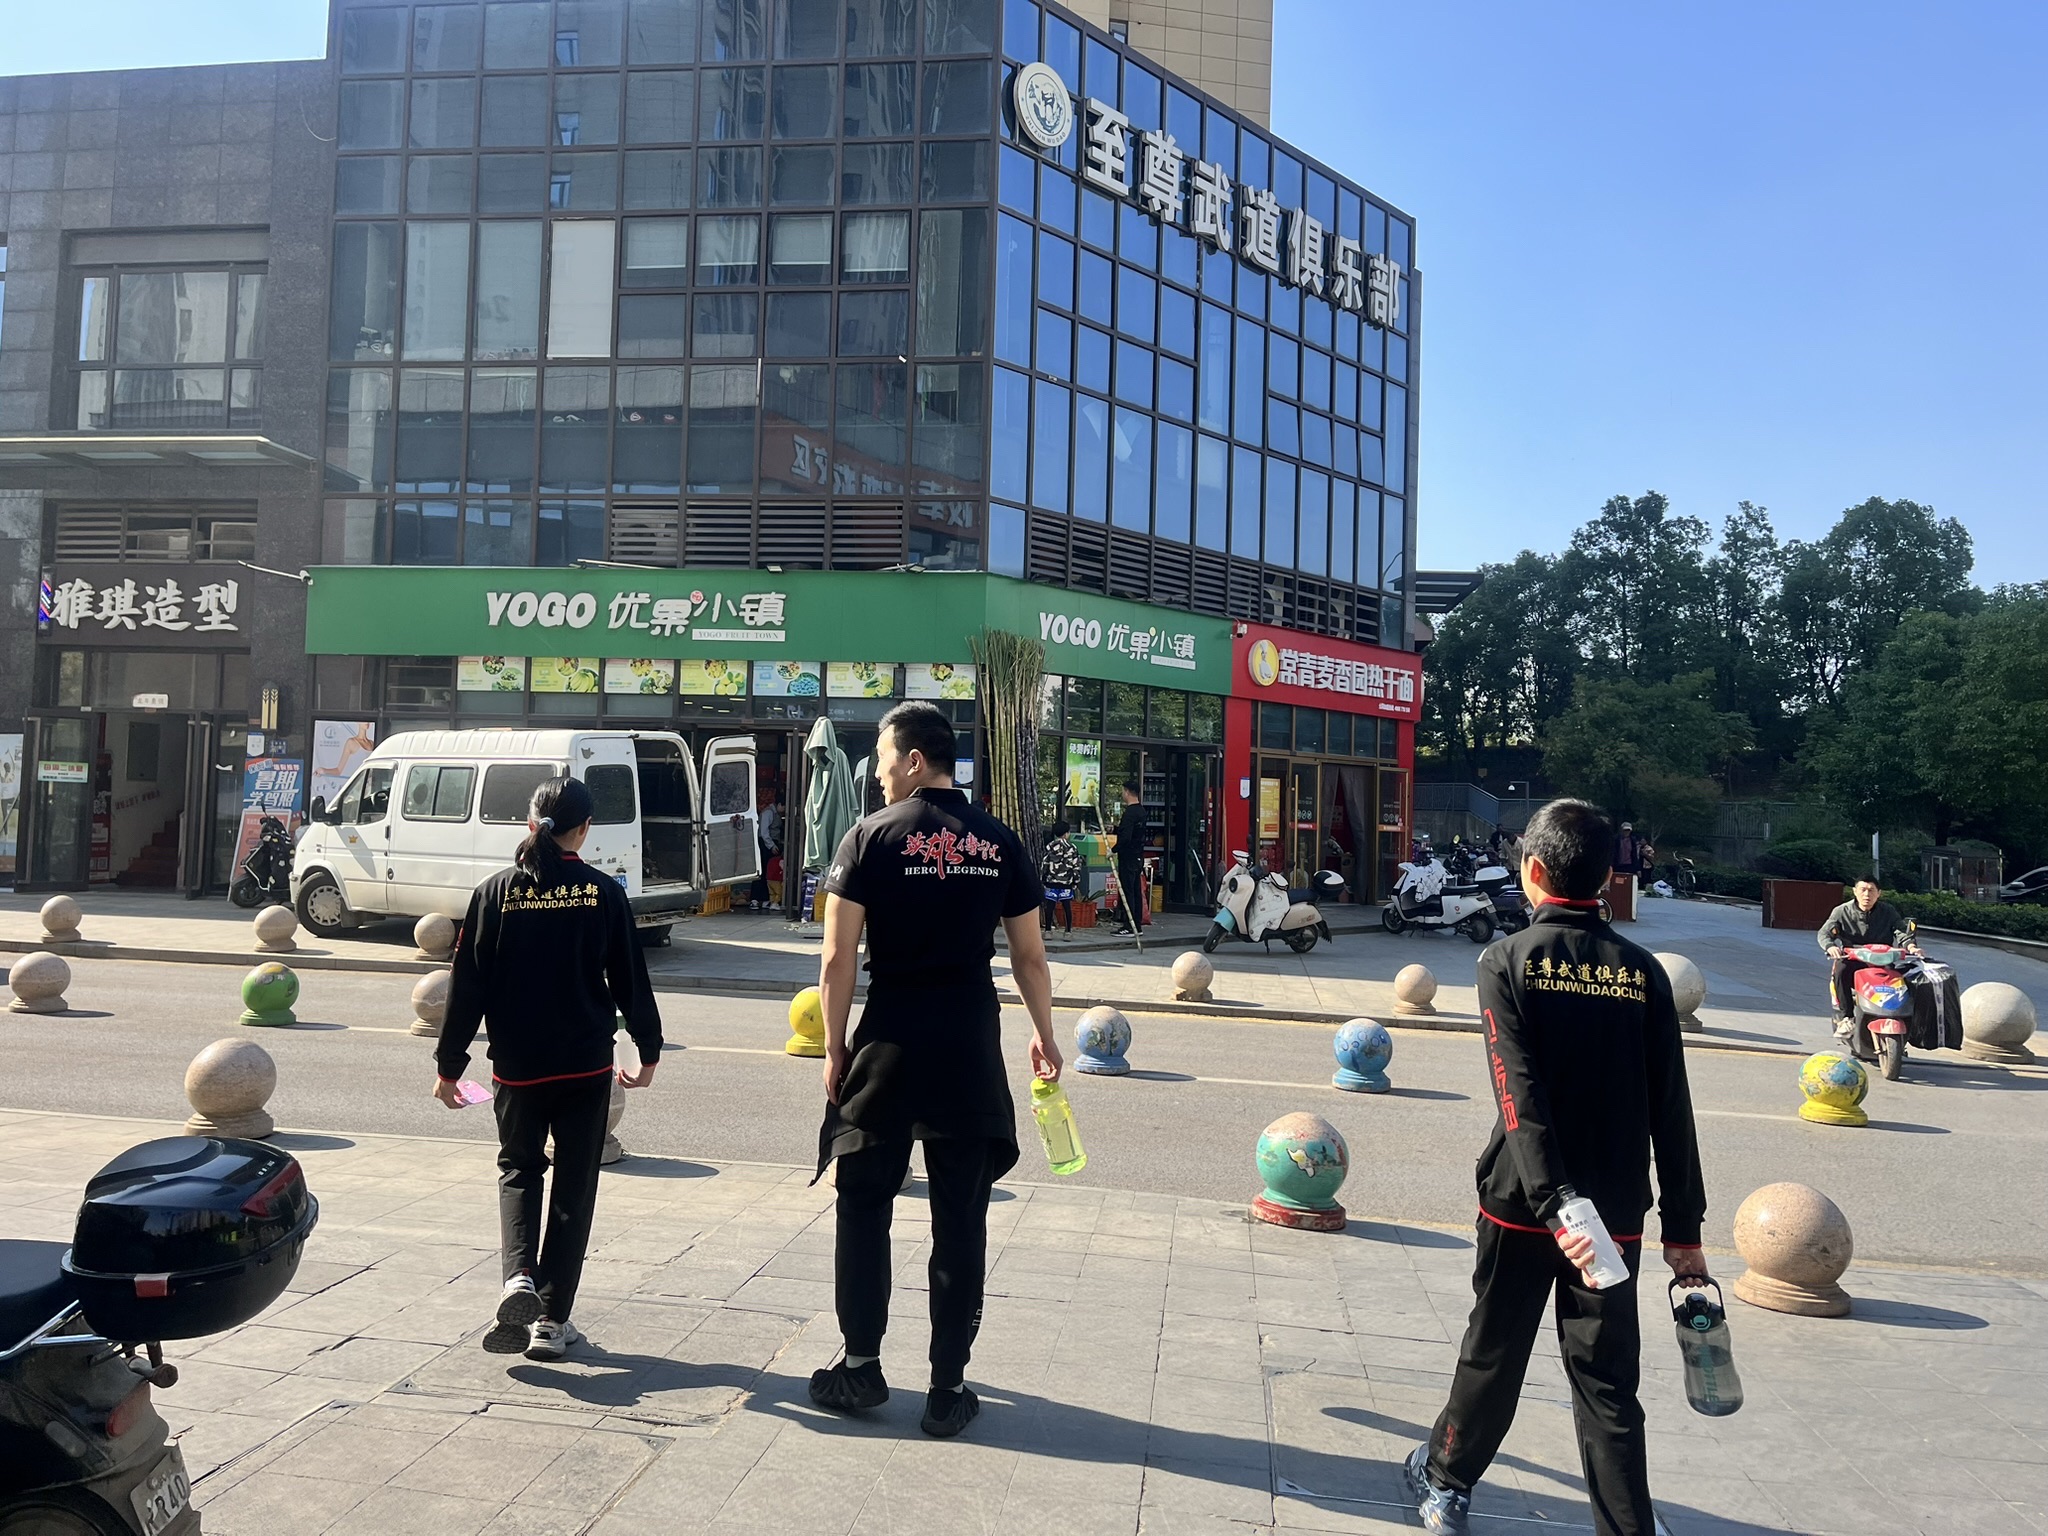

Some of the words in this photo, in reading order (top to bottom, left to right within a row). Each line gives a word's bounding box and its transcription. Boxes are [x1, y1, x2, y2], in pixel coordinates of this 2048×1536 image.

[1083, 97, 1401, 327] 至尊武道俱乐部
[49, 578, 240, 632] 雅琪造型
[486, 591, 597, 629] YOGO
[607, 591, 787, 637] 优果小镇
[698, 631, 722, 640] YOGO
[725, 631, 750, 640] FRUIT
[754, 632, 779, 640] TOWN
[1039, 612, 1102, 649] YOGO
[1107, 622, 1196, 661] 优果小镇
[1278, 648, 1414, 702] 常青麦香园热干面
[255, 770, 298, 790] 暑期
[904, 866, 938, 876] HERO
[946, 866, 999, 877] LEGENDS
